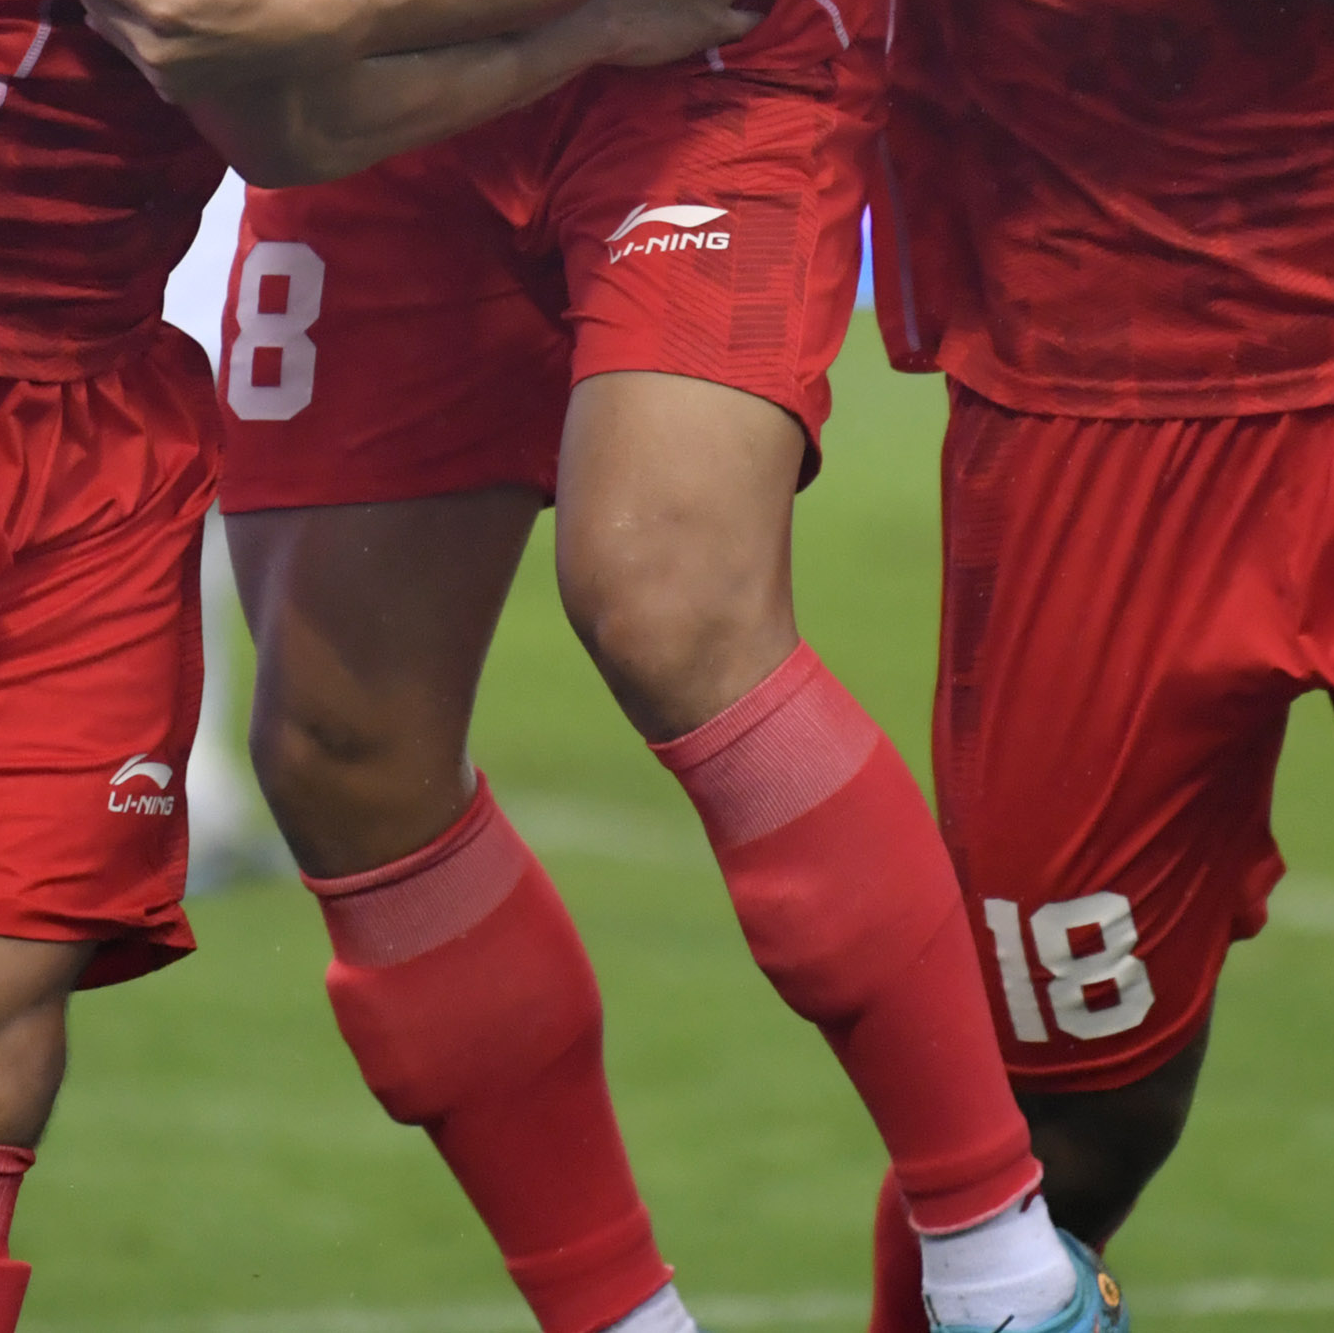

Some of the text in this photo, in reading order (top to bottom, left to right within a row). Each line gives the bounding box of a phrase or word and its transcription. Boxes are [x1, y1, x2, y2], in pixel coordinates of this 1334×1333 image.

[609, 232, 730, 264] LI-NING
[227, 241, 326, 421] 8
[108, 791, 174, 816] LI-NING
[984, 890, 1155, 1044] 18
